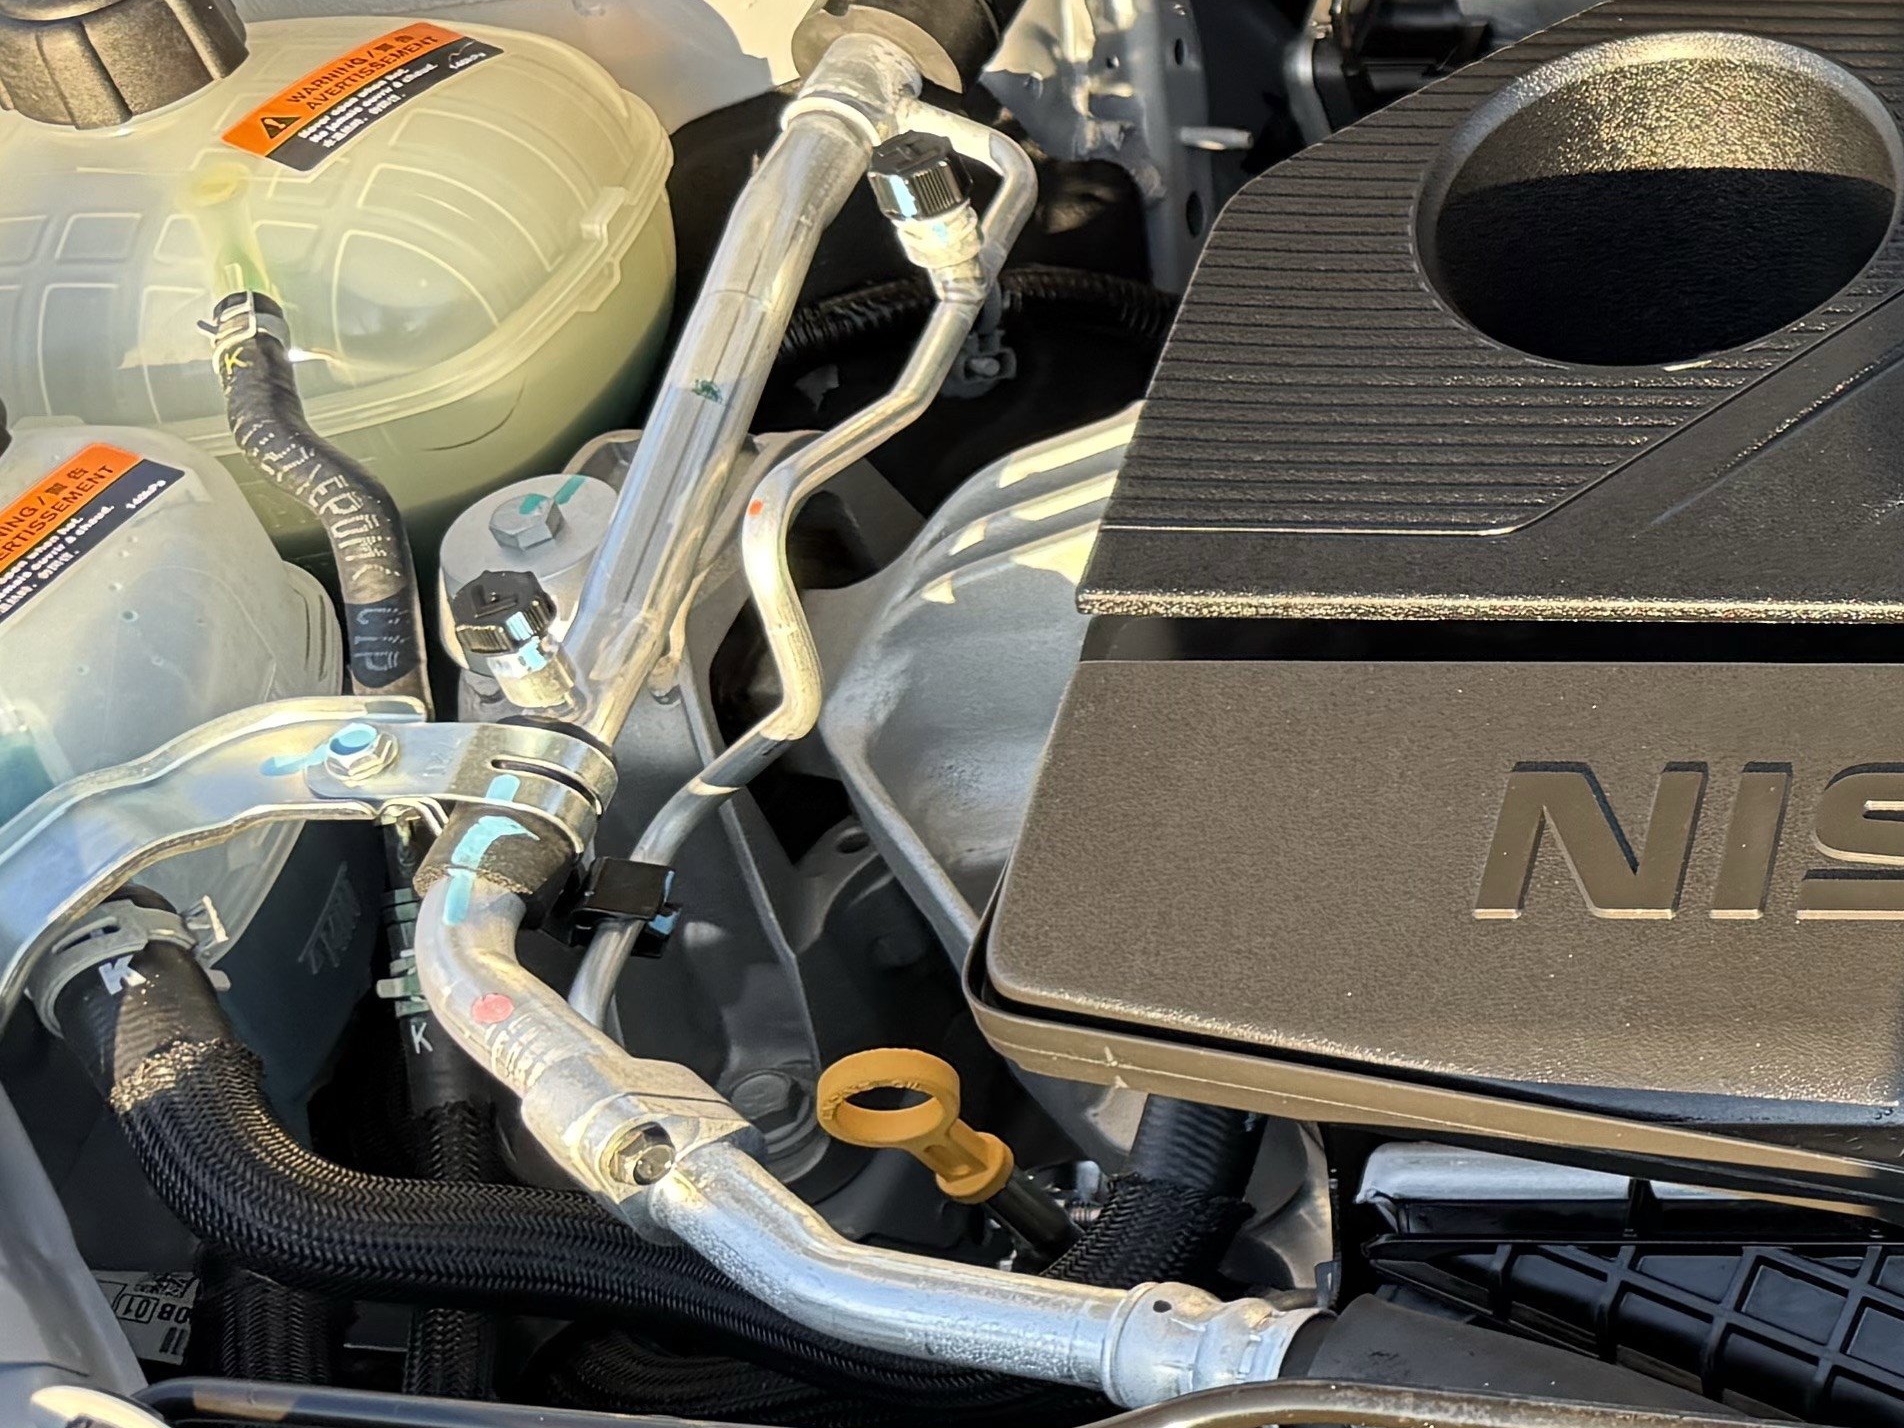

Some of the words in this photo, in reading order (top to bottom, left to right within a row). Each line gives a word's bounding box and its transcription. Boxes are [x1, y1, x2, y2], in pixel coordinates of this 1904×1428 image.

[287, 55, 367, 105] WARNING
[306, 36, 438, 110] AVERTISSEMENT
[224, 346, 253, 376] K
[409, 1021, 434, 1055] K
